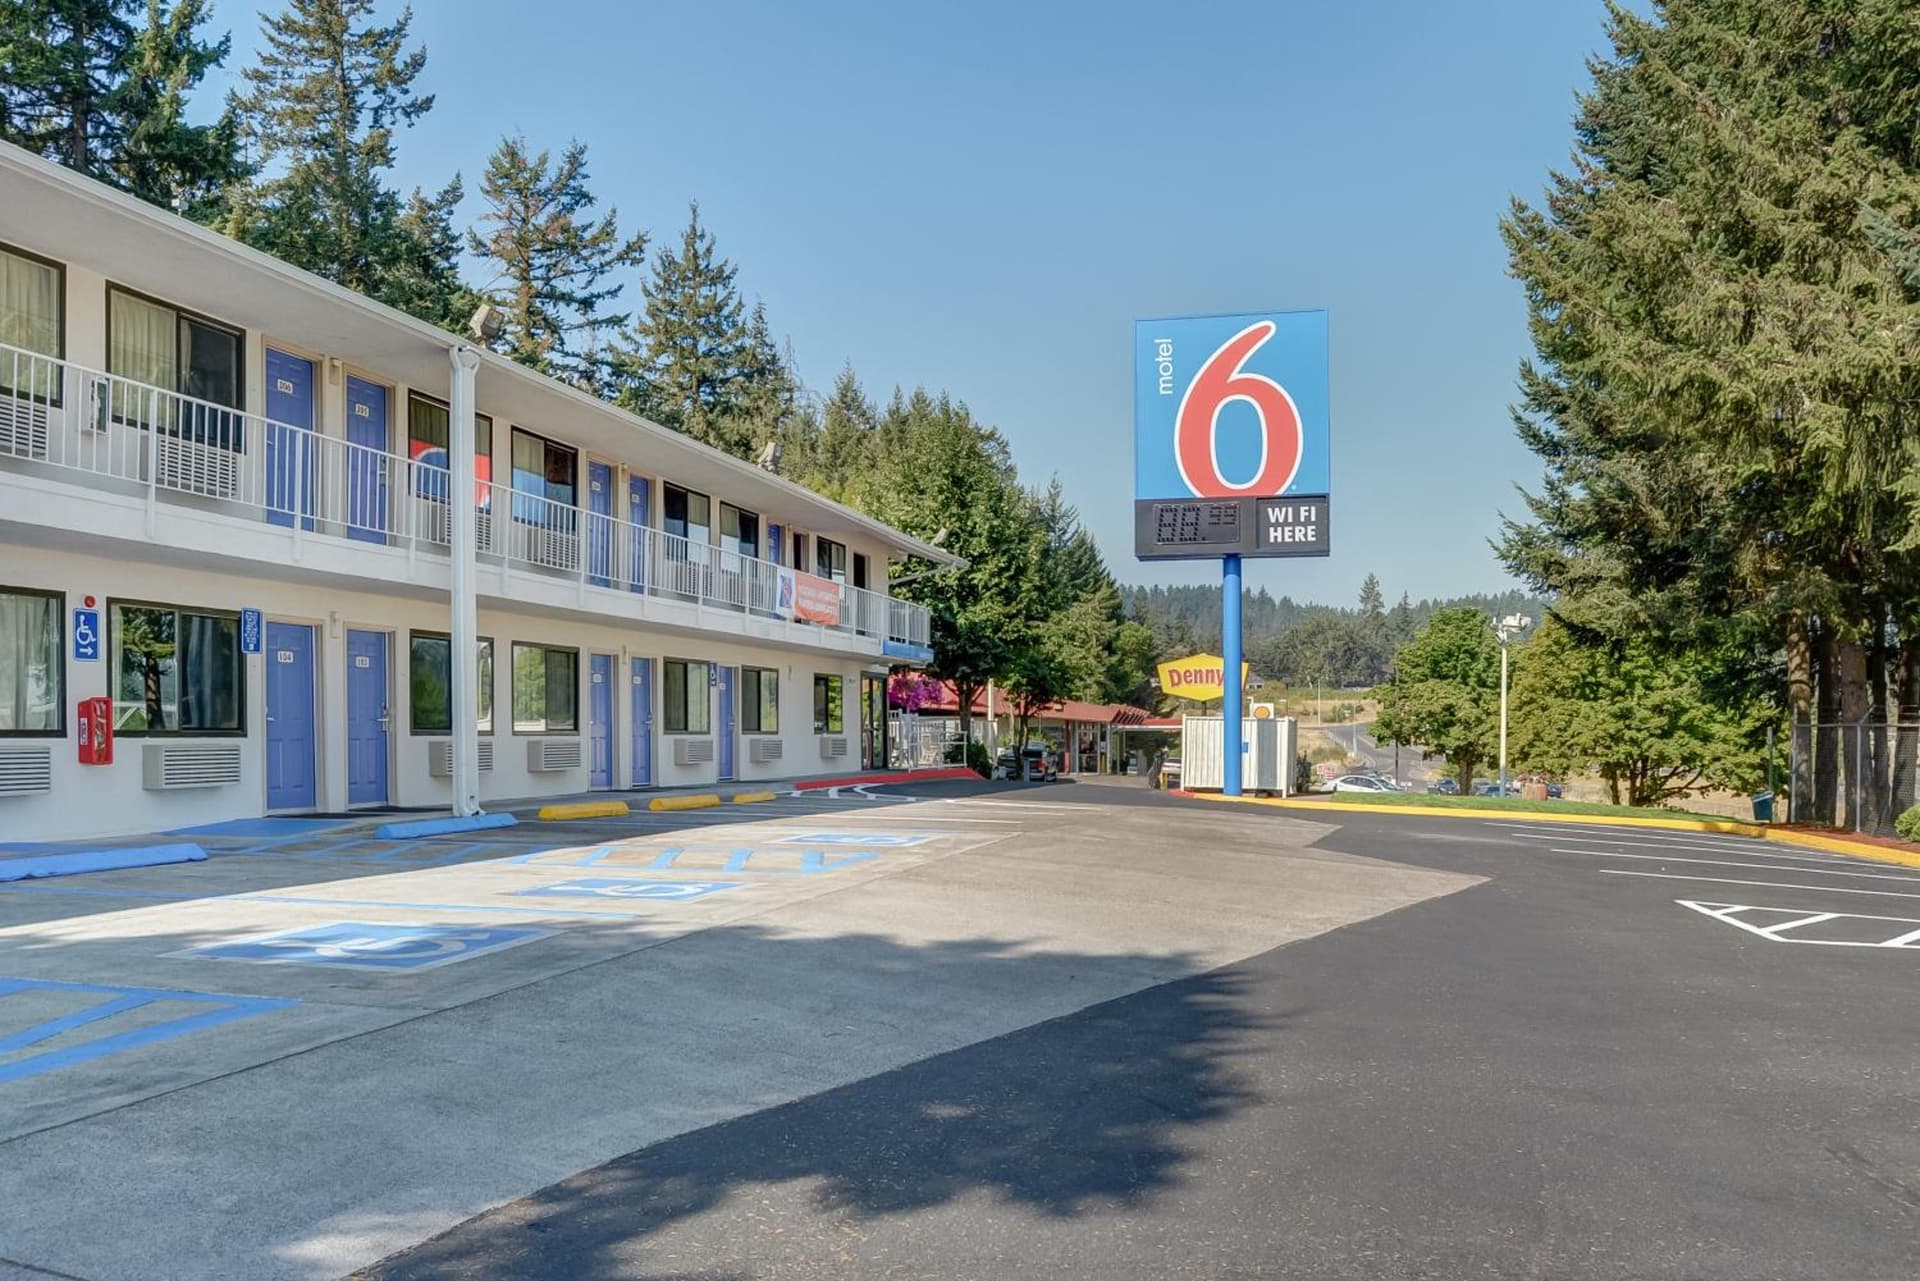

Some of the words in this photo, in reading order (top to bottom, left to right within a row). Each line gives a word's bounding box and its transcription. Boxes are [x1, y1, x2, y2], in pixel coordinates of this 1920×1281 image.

[1154, 338, 1174, 395] motel
[1174, 320, 1304, 498] 6
[1267, 507, 1293, 523] WI
[1300, 506, 1316, 522] FI
[1269, 525, 1316, 543] HERE
[1168, 668, 1224, 687] Denny
